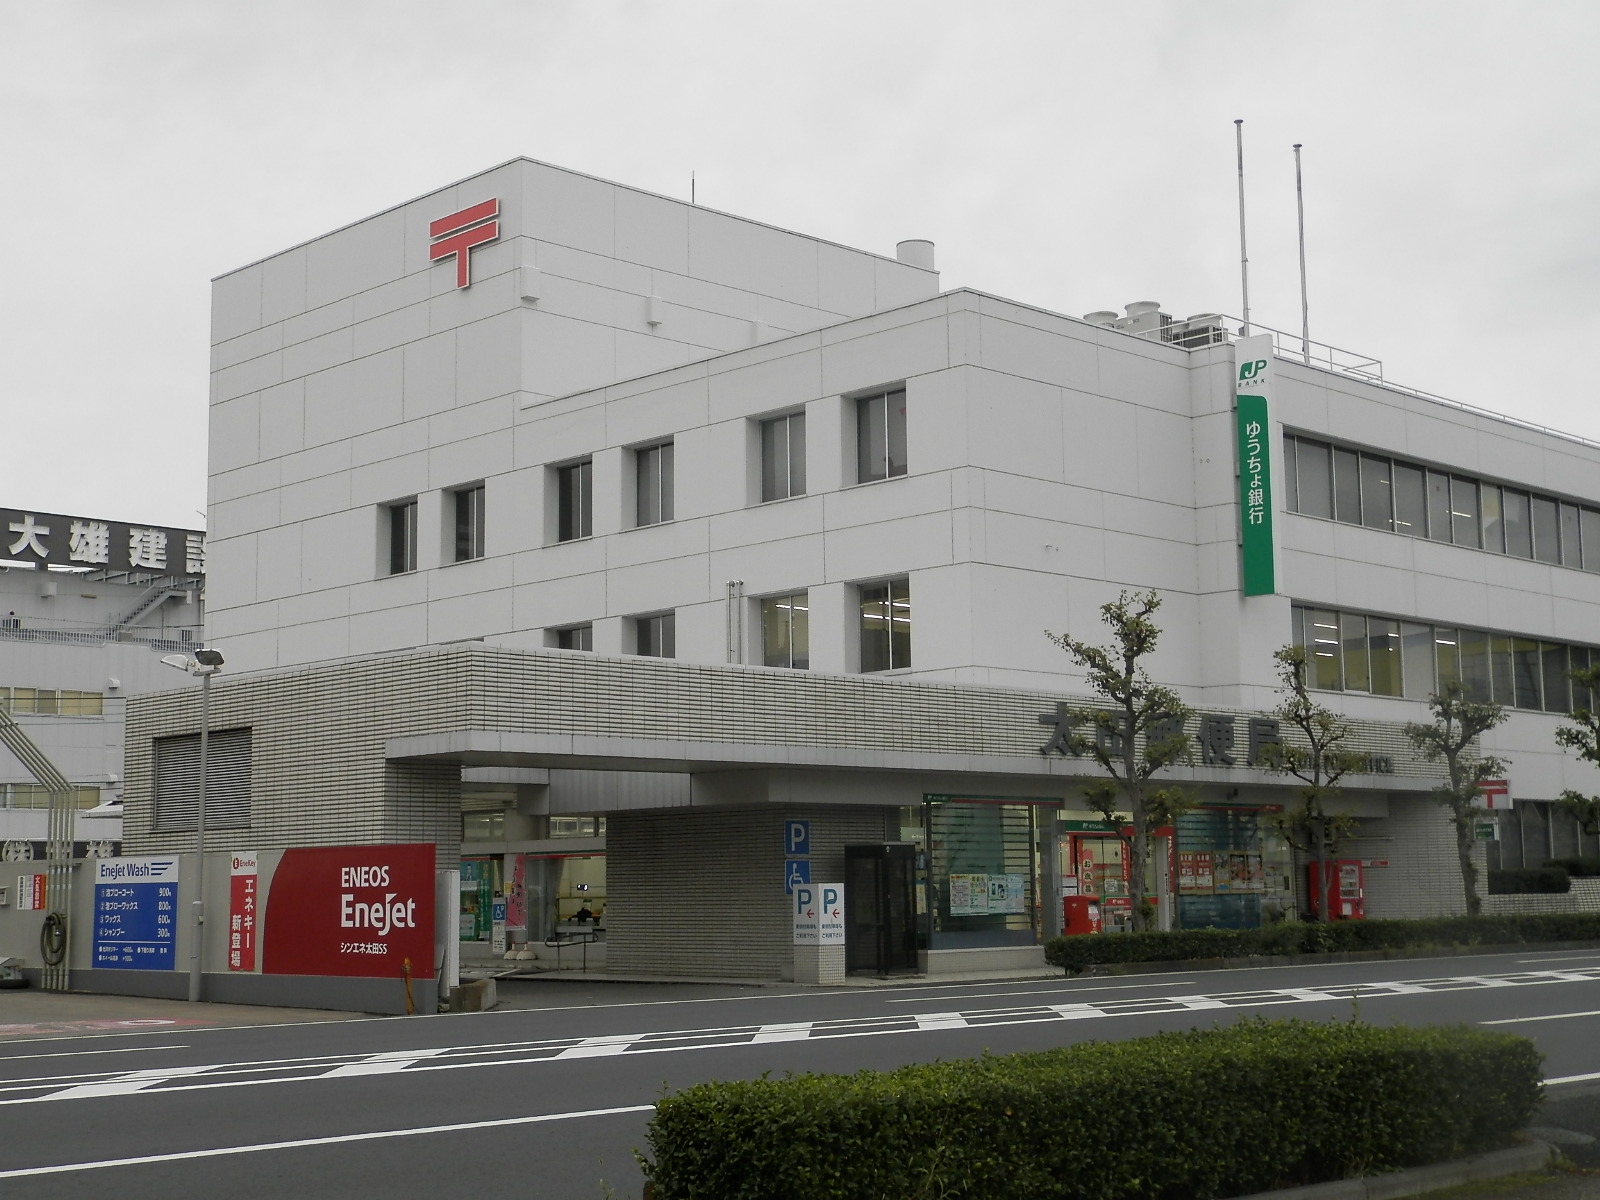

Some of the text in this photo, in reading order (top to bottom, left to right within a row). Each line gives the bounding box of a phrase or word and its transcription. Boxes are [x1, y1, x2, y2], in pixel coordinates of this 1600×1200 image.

[1239, 360, 1267, 380] JP
[1238, 378, 1265, 388] BANK
[1246, 421, 1265, 525] ゆうちょ銀行
[791, 823, 805, 852] P
[127, 863, 150, 877] Wash
[341, 866, 390, 888] ENEOS
[244, 879, 254, 948] エネキー
[797, 889, 812, 914] P
[823, 888, 838, 914] P
[231, 914, 241, 967] 新登場
[340, 942, 388, 955] シンエネ太田SS
